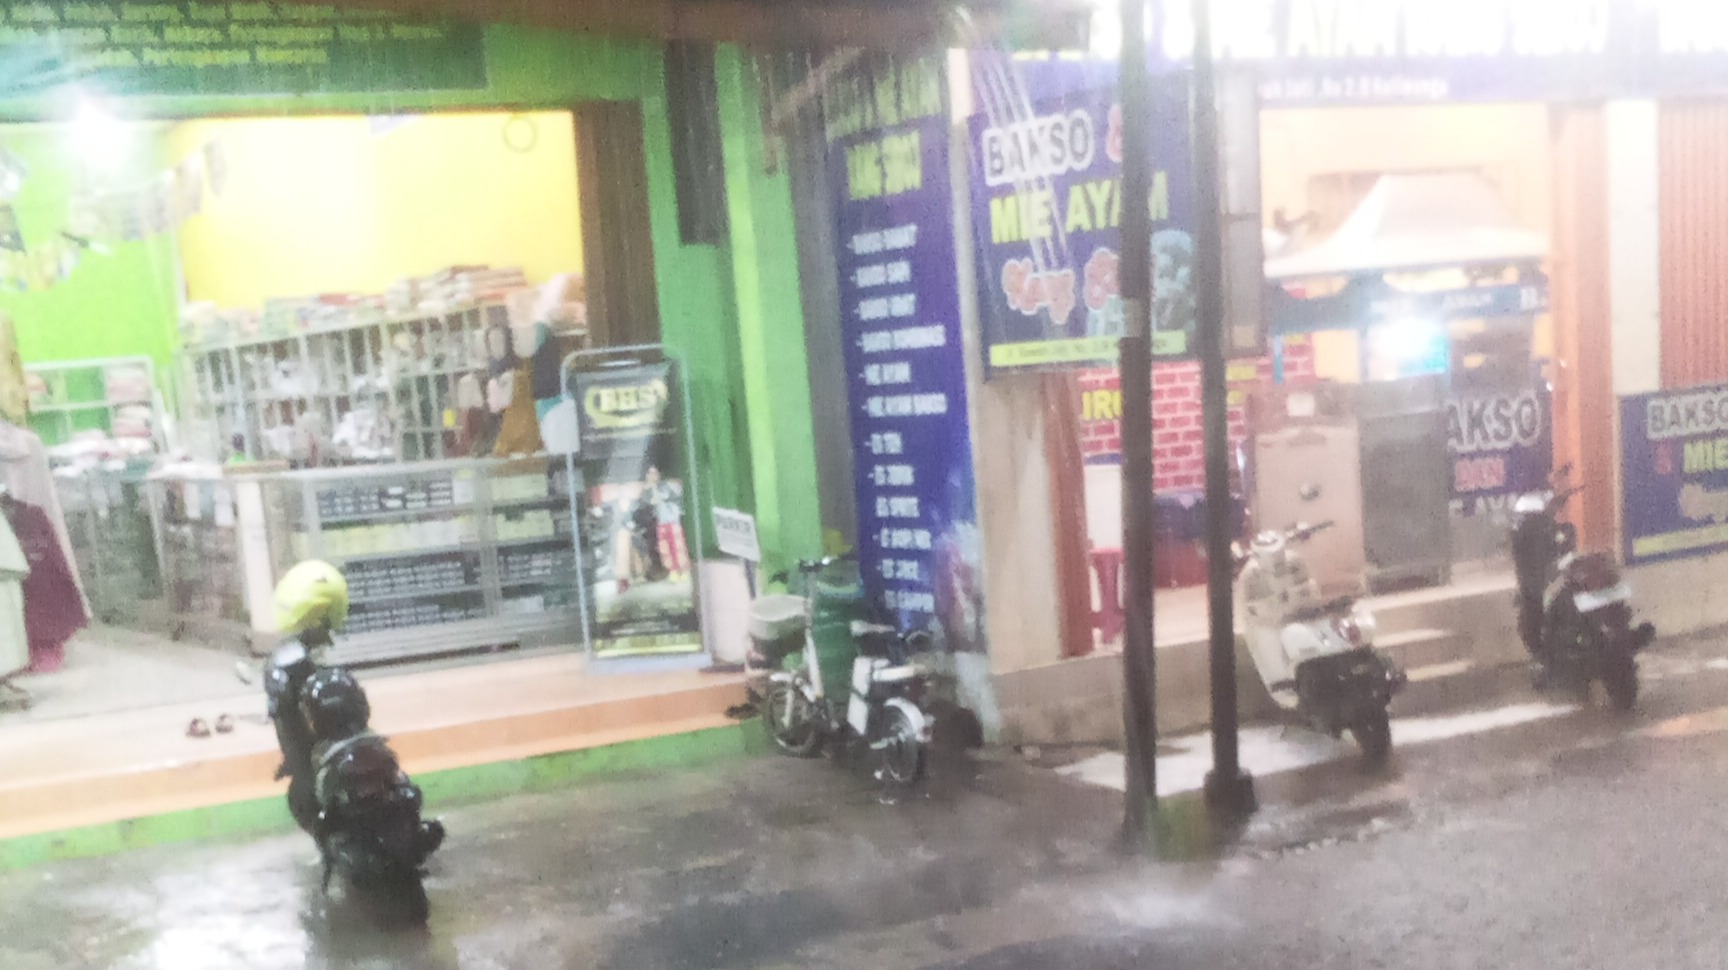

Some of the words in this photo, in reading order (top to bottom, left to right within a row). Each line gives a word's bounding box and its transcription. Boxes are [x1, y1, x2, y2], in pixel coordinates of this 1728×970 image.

[981, 111, 1092, 184] BAKSO
[990, 188, 1054, 244] MIE
[1447, 394, 1541, 452] AKSO
